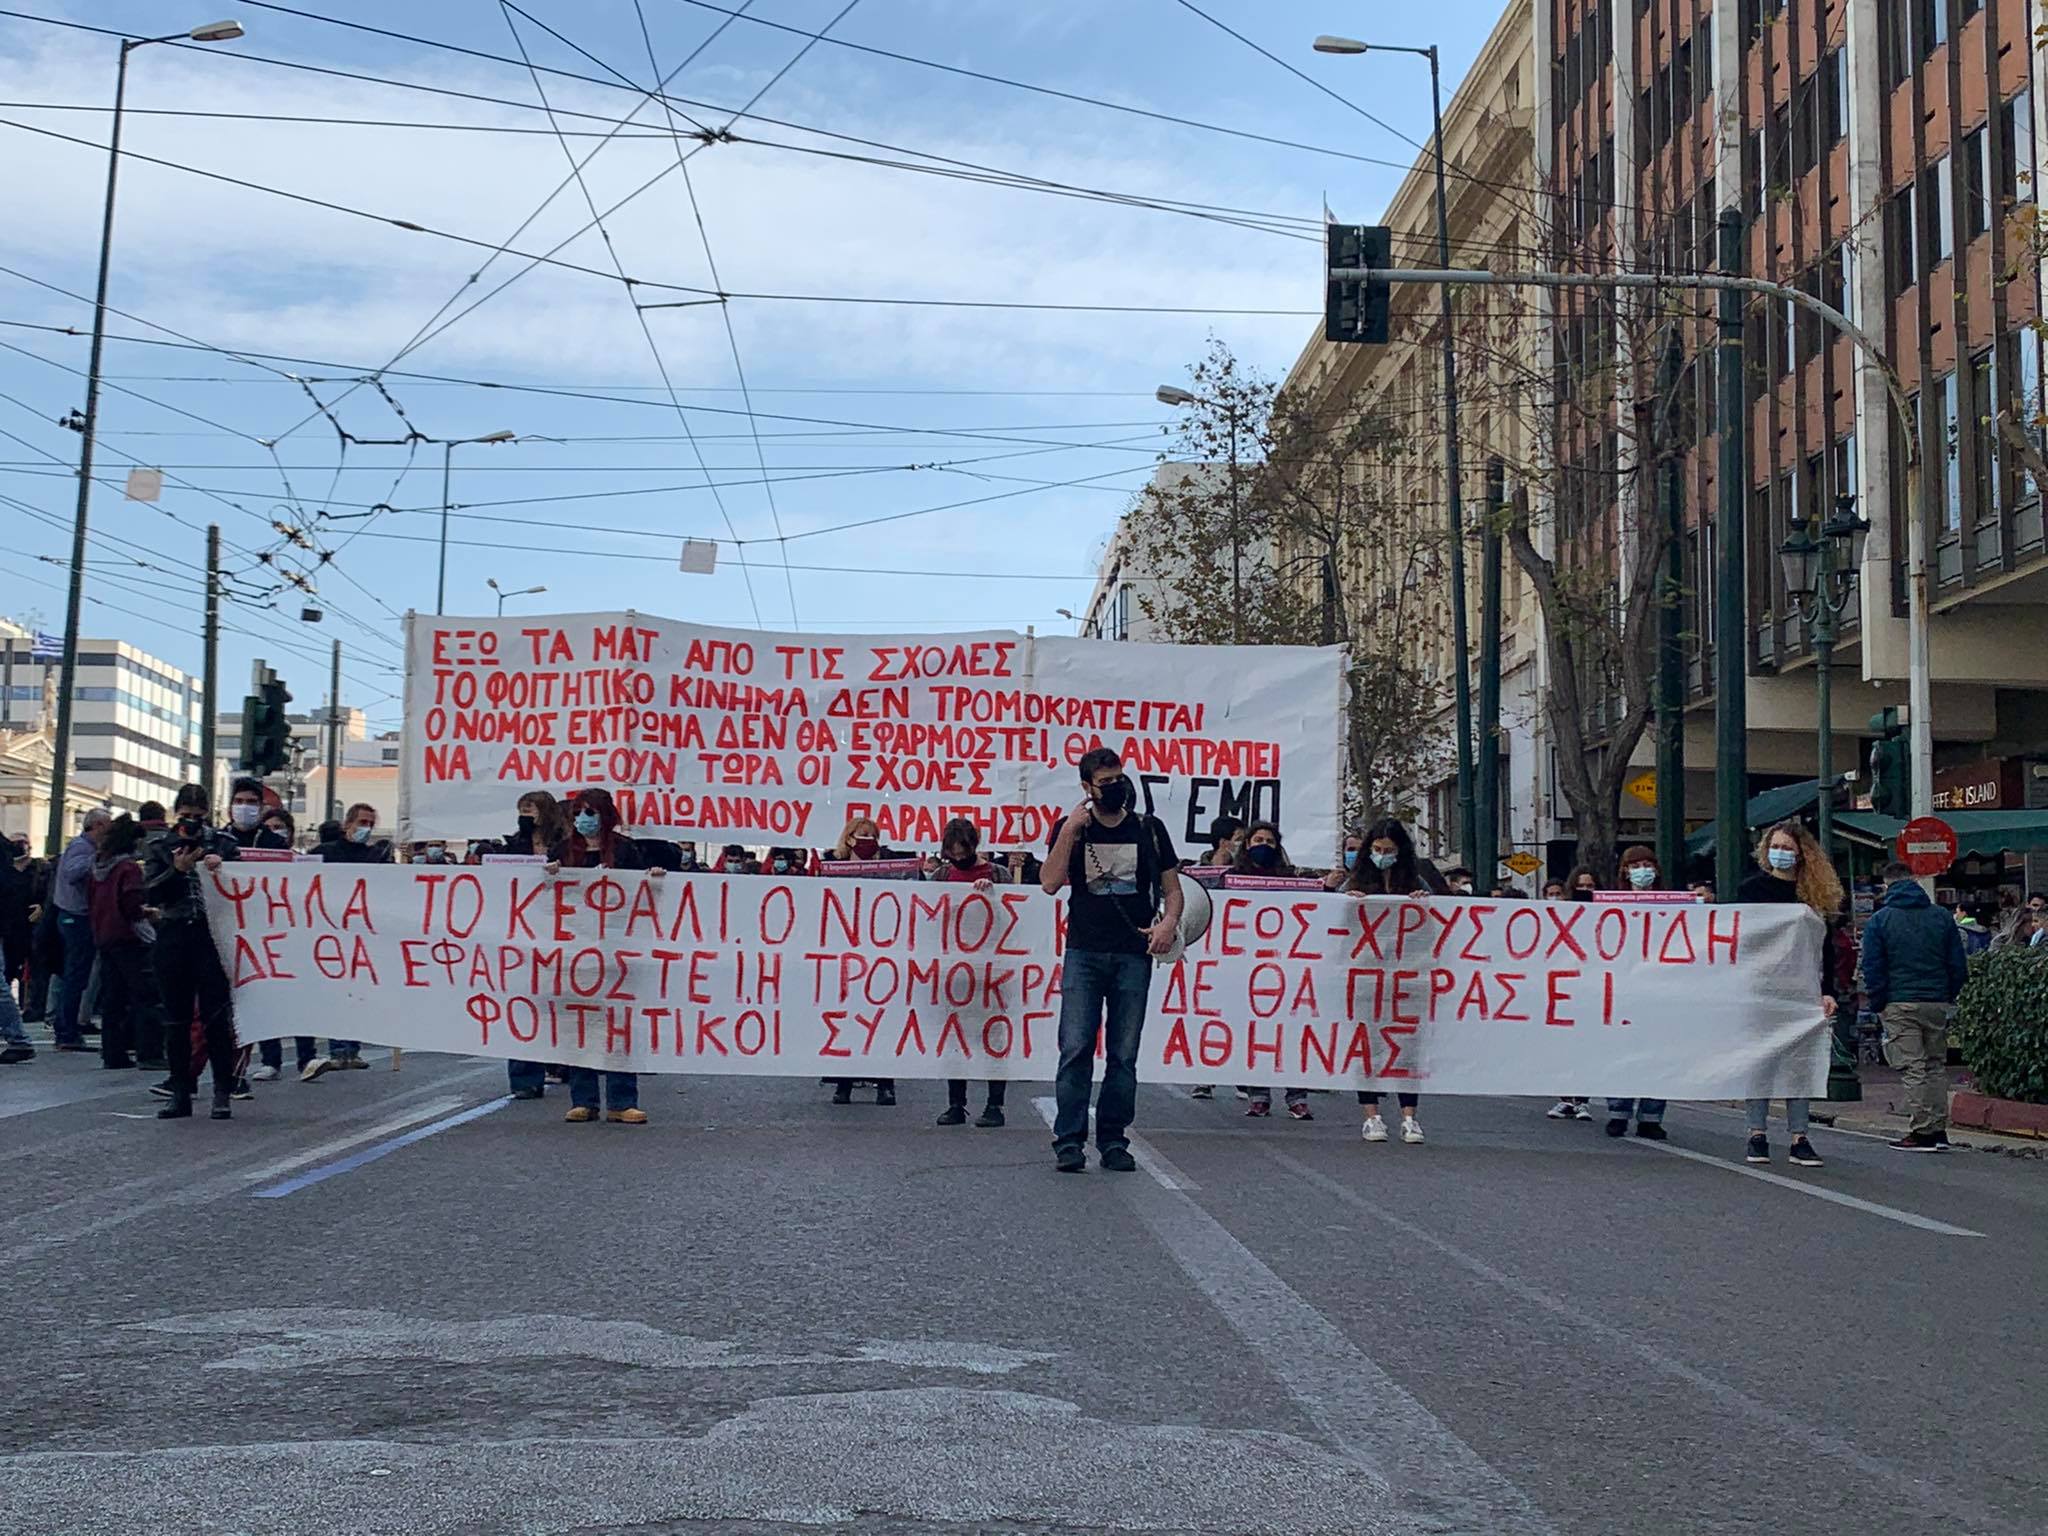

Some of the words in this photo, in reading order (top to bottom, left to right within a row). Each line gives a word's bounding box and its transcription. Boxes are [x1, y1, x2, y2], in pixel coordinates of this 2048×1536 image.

[432, 629, 500, 667] ΕΞΩ
[521, 628, 575, 665] ΤΑ
[592, 624, 660, 662] ΜΑΤ
[683, 639, 754, 676] ΑΠΟ
[775, 645, 845, 681] ΤΙΣ
[867, 641, 1016, 683] ΣΧΟΛΕΣ
[432, 668, 478, 710] ΤΟ
[484, 667, 656, 711] ΦΟΙΤΗΤΙΚΟ
[668, 673, 809, 719] ΚΙΝΗΜΑ
[827, 686, 910, 721] ΔΕΝ
[928, 684, 1206, 733] ΤΡΟΜΟΚΡΑΤΕΙΤΑΙ
[423, 744, 472, 785] ΝΑ
[498, 746, 678, 786] ΑΝΟΙΞΟΥΝ
[697, 751, 784, 787] ΤΩΡΑ
[796, 753, 832, 788] ΟΙ
[845, 752, 993, 796] ΣΧΟΛΕΣ
[425, 706, 447, 742] Ο
[452, 708, 558, 748] ΝΟΜΟΣ
[566, 705, 706, 751] ΕΚΤΡΩΜΑ
[714, 713, 788, 752] ΔΕΝ
[796, 718, 838, 754] ΘΑ
[850, 719, 1058, 770] ΕΦΑΡΜΟΣΤΕΙ,
[1118, 736, 1281, 780] ΑΝΑΤΡΑΠΕΙ
[566, 786, 813, 838] ΠΑΪΩΑΝΝΟΥ
[1184, 777, 1281, 844] ΕΜΠ
[1965, 781, 1997, 805] ISLAND
[213, 872, 377, 935] ΨΗΛΑ
[414, 873, 486, 940] ΤΟ
[507, 873, 742, 945] ΚΕΦΑΛΙ.
[758, 884, 797, 946] Ο
[819, 886, 1030, 957] ΝΟΜΟΣ
[234, 932, 297, 988] ΔΕ
[313, 934, 379, 986] ΘΑ
[1161, 958, 1222, 1019] ΔΕ
[1248, 962, 1320, 1019] ΘΑ
[1345, 966, 1633, 1028] ΠΕΡΑΣΕΙ.
[466, 992, 783, 1058] ΦΟΙΤΗΤΙΚΟΙ
[1162, 1016, 1431, 1079] ΑΘΗΝΑΣ
